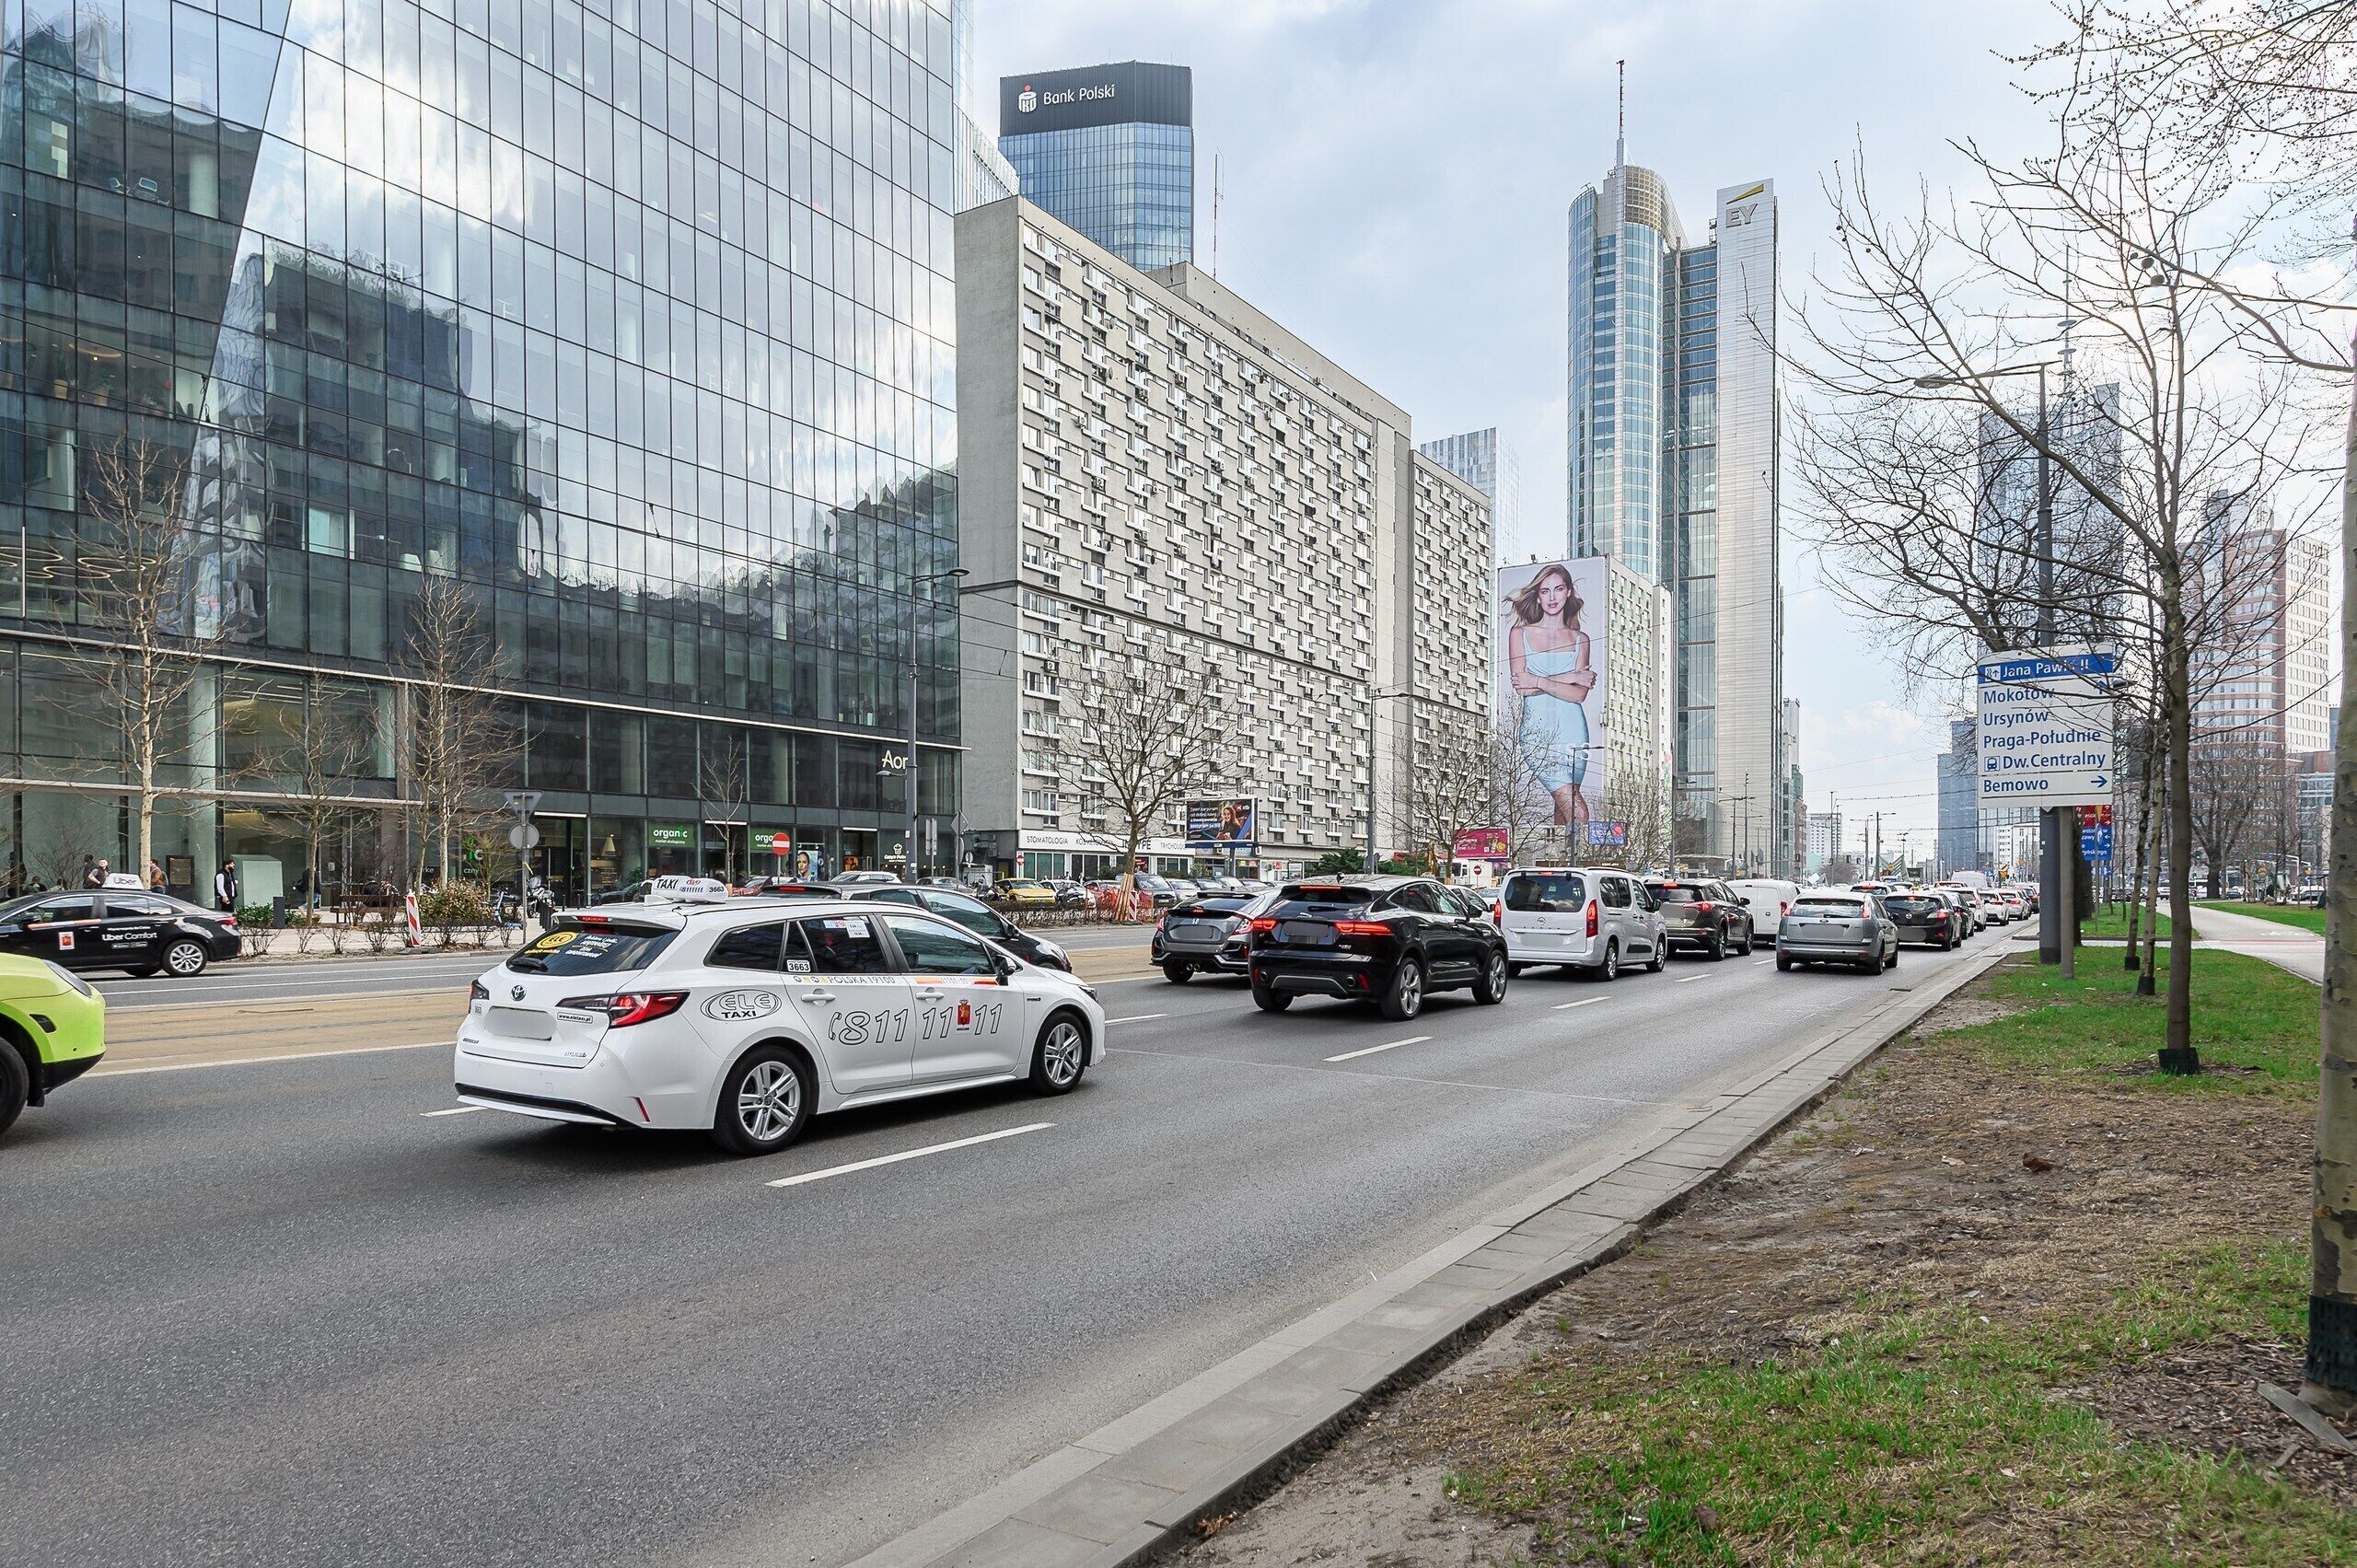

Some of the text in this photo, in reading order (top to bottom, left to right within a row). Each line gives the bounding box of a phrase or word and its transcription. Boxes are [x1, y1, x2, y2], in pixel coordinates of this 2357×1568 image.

[1043, 88, 1074, 105] Bank
[1079, 84, 1115, 100] Polski
[1726, 203, 1758, 228] EY
[2003, 666, 2031, 678] Jana
[2036, 659, 2074, 674] Paw
[1984, 709, 2049, 727] Ursynów
[1983, 728, 2101, 749] Praga-Południe
[1984, 779, 2049, 793] Bemowo
[653, 827, 688, 839] organic
[1026, 835, 1068, 845] STOMATOLOGIA
[656, 878, 679, 889] TAXI
[102, 932, 157, 941] Uber Comfort
[788, 963, 809, 971] 3663
[869, 975, 896, 984] 19100
[719, 993, 772, 1011] ELE
[559, 1014, 592, 1022] www.eletaxi.pl
[721, 1010, 757, 1019] TAXI
[839, 1003, 1003, 1046] 811 11 11
